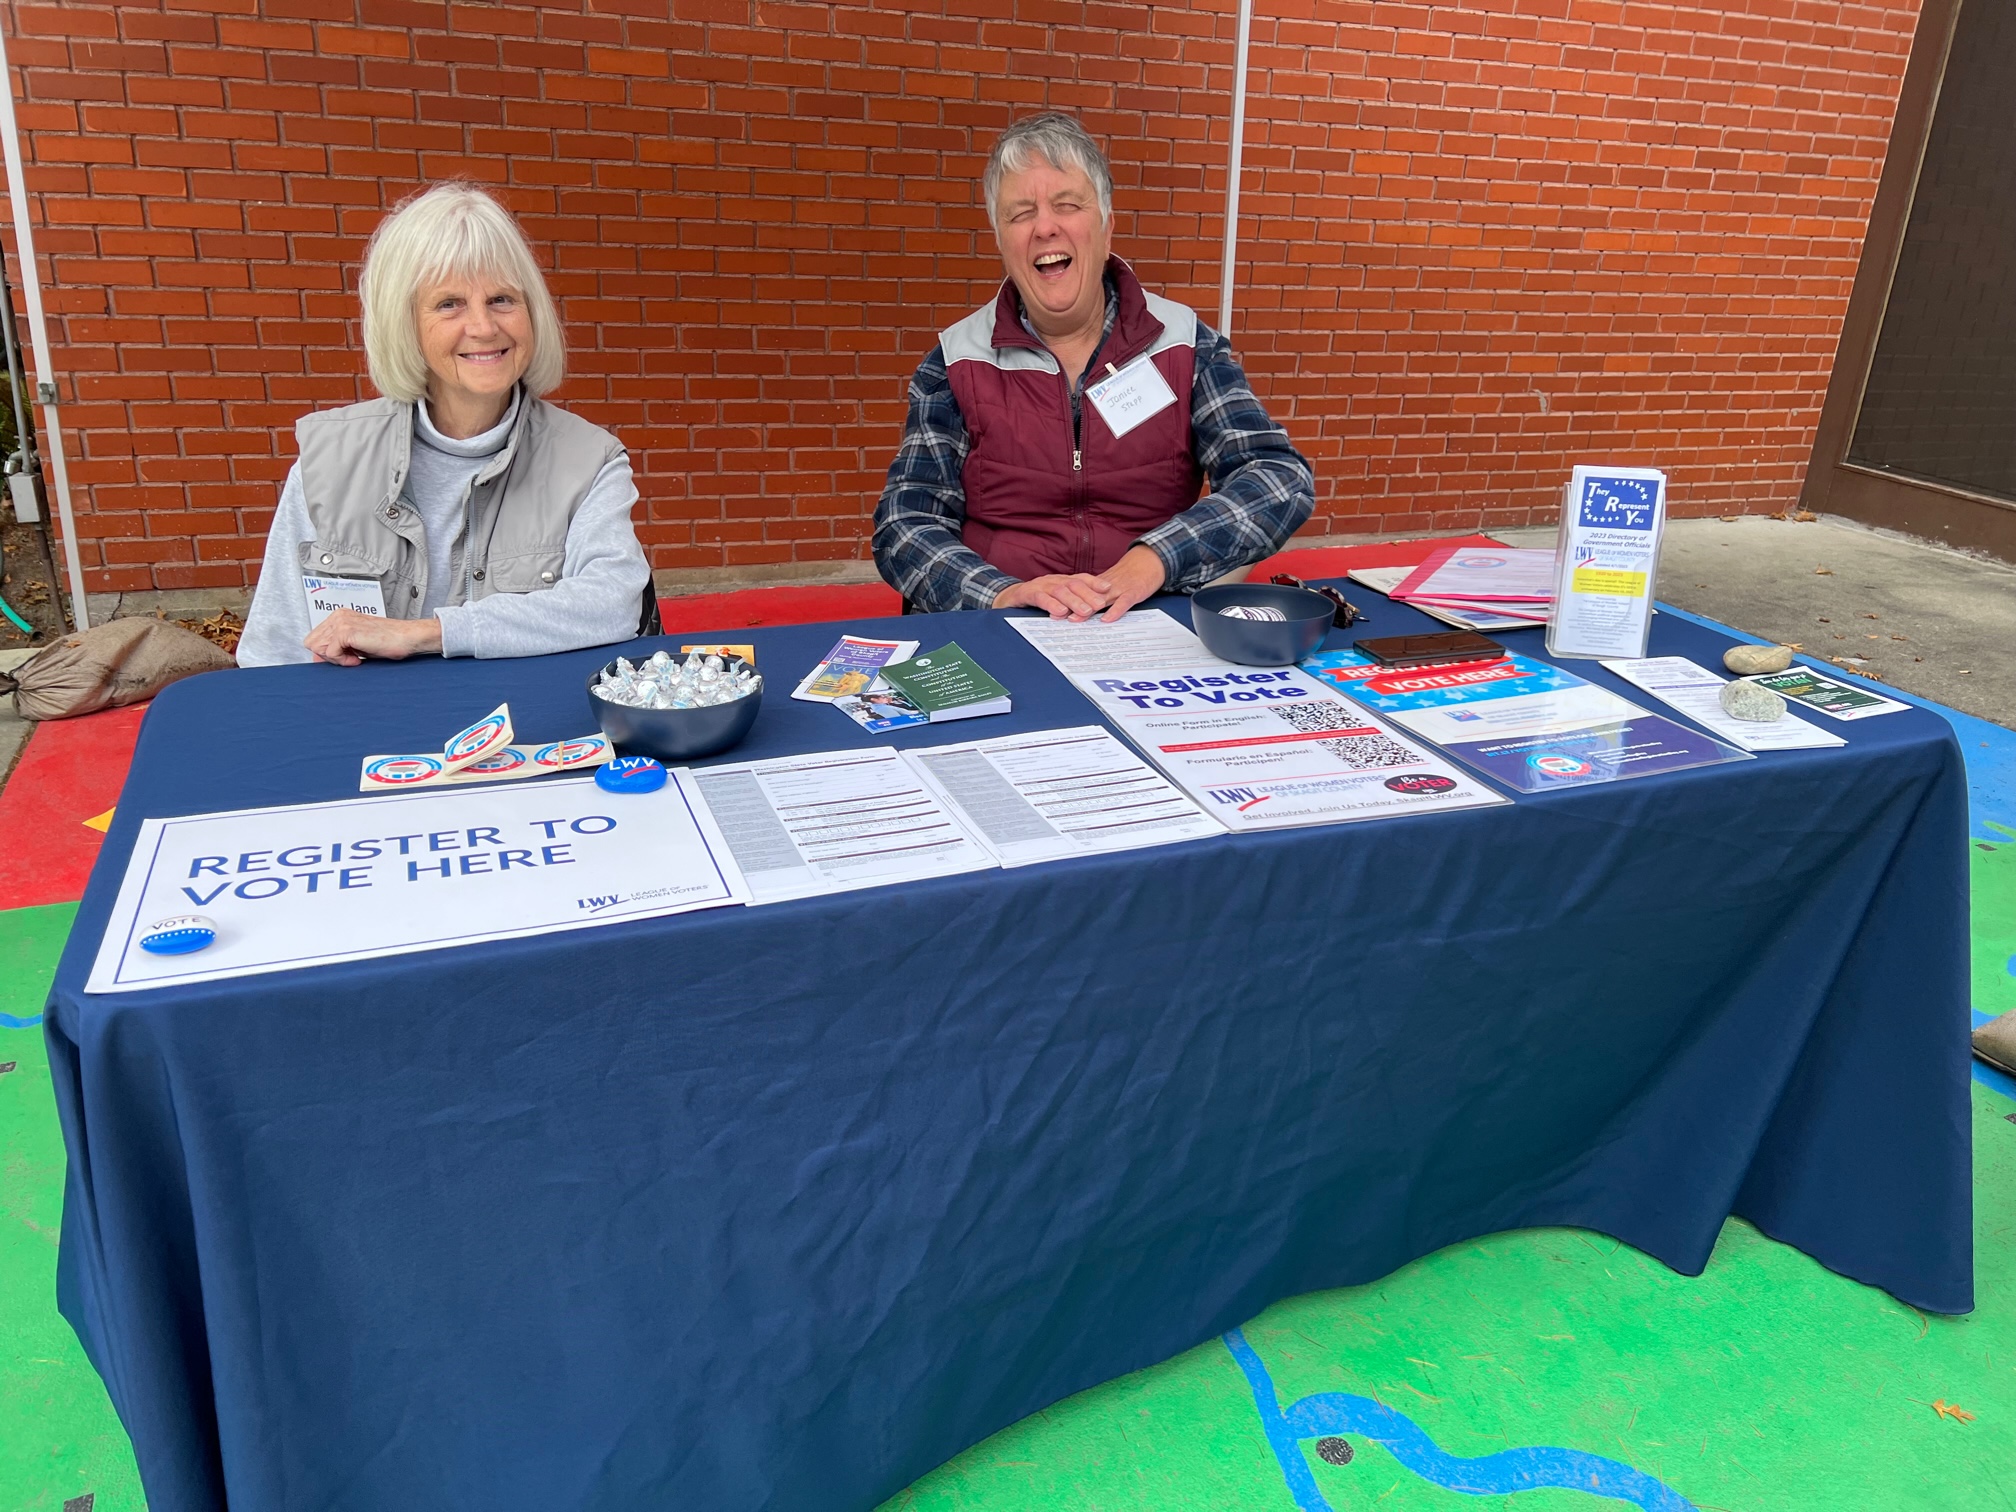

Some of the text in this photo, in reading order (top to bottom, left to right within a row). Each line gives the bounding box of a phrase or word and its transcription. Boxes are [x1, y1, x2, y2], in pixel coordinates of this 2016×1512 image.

[1588, 482, 1610, 498] They
[1604, 496, 1650, 512] Represent
[1626, 510, 1644, 526] You
[1583, 539, 1651, 549] Government Officials
[1607, 533, 1638, 541] Directory
[1575, 546, 1594, 560] LWV
[304, 578, 322, 588] LWV
[834, 664, 874, 675] VOTE
[1091, 670, 1290, 693] Register
[1382, 668, 1516, 691] VOTE HERE
[1118, 686, 1308, 709] To Vote
[1224, 714, 1267, 722] English:
[1182, 720, 1241, 731] Participate!
[609, 758, 656, 771] LWV
[1186, 755, 1247, 764] Formulario
[1225, 756, 1285, 767] Participen!
[1256, 784, 1298, 793] LEAGUE
[1308, 778, 1348, 788] WOMEN
[1347, 775, 1386, 784] VOTERS
[1388, 778, 1454, 792] VOTER
[1400, 776, 1418, 784] Be
[1206, 786, 1258, 804] LWV
[1274, 784, 1363, 798] OF SKAGIT COUNTY
[1318, 804, 1340, 812] Join
[188, 815, 617, 878] REGISTER TO
[180, 844, 577, 906] VOTE HERE
[630, 888, 667, 897] LEAGUE
[631, 884, 708, 901] WOMEN VOTERS
[576, 894, 619, 909] LWV
[151, 917, 201, 930] VOTE
